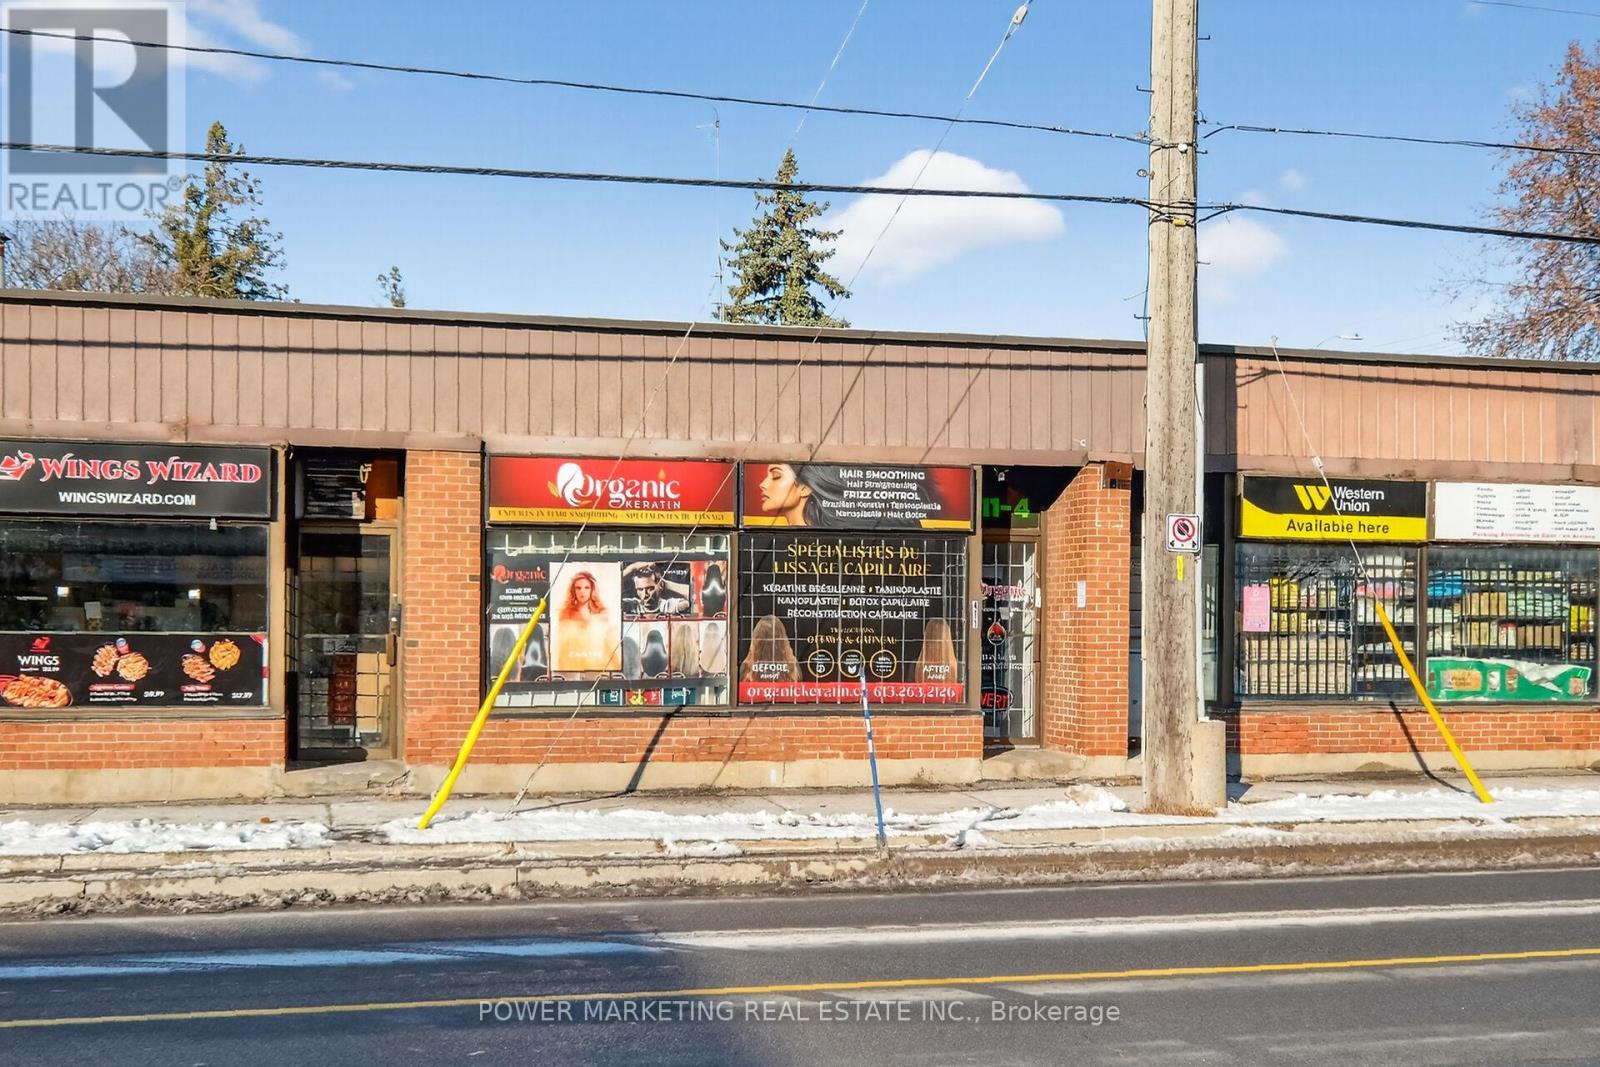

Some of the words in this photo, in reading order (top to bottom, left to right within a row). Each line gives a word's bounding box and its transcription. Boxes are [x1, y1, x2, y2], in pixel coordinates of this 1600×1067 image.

[38, 453, 141, 482] WINGS
[146, 456, 263, 485] WIZARD
[839, 469, 864, 479] HAIR
[865, 470, 926, 480] SMOOTHING
[556, 462, 681, 508] Organic
[59, 491, 196, 506] WINGSWIZARD.COM
[843, 490, 872, 499] FRIZZ
[872, 491, 921, 500] CONTROL
[1334, 486, 1385, 500] Western
[625, 500, 681, 509] KERATIN
[1334, 500, 1370, 513] Union
[1286, 519, 1353, 533] Available
[1357, 520, 1390, 534] here
[899, 546, 919, 560] DU
[774, 561, 838, 574] LISSAGE
[844, 562, 931, 577] CAPILLAIRE
[849, 597, 879, 607] BOTOX
[17, 655, 60, 666] WINGS
[752, 663, 789, 673] BEFORE
[922, 664, 951, 673] AFTER
